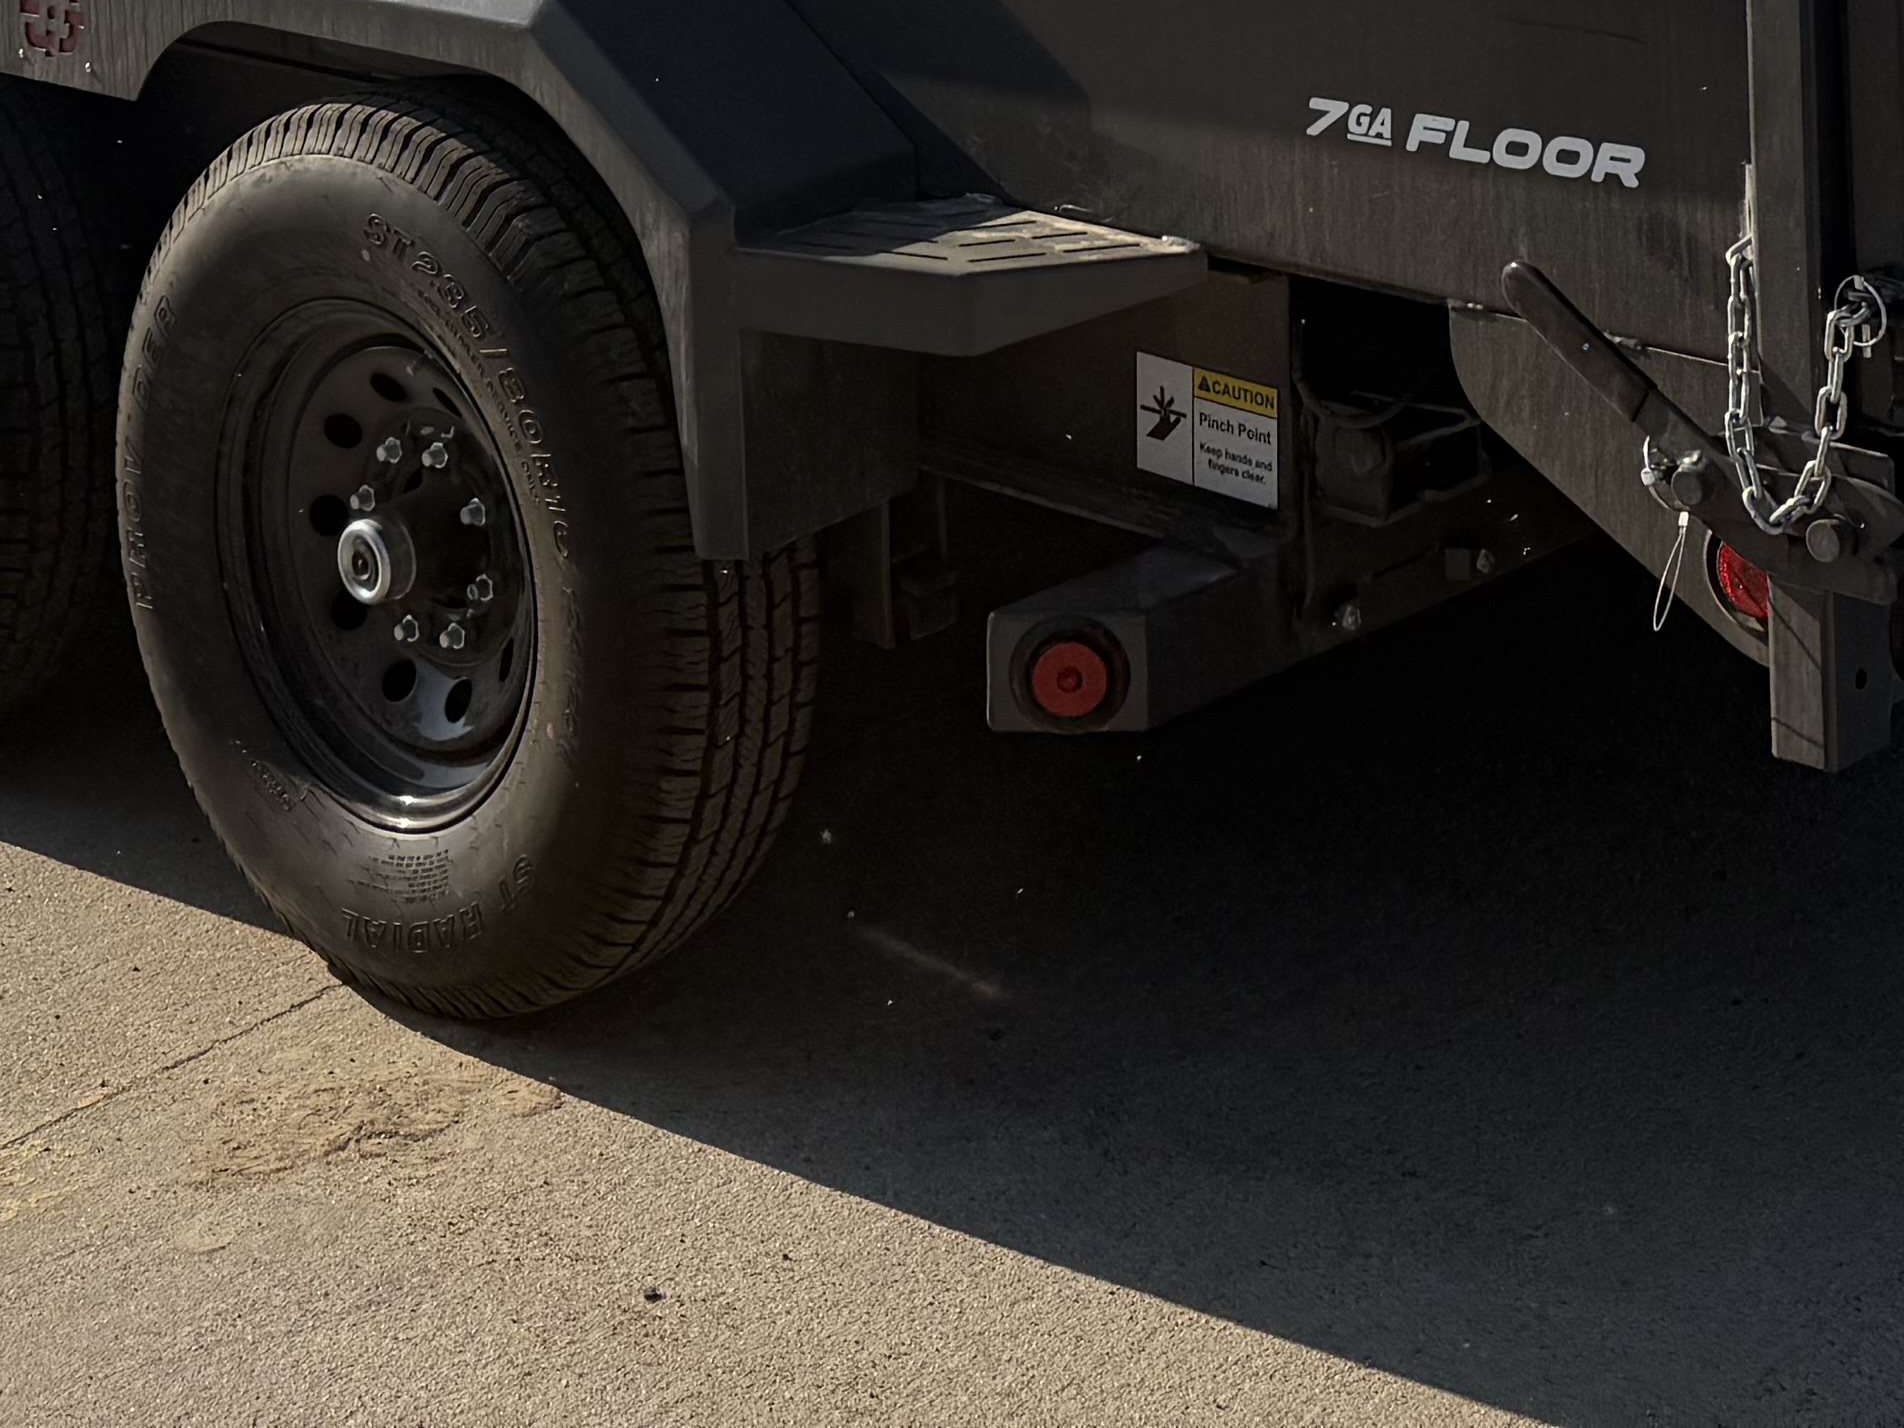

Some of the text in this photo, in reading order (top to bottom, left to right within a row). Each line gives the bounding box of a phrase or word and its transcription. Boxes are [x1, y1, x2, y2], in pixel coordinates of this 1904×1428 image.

[1406, 113, 1646, 188] FLOOR
[1212, 380, 1275, 410] CAUTION
[1199, 412, 1272, 445] Pinch Point
[1199, 442, 1273, 472] Keep hands and
[1208, 458, 1267, 485] fingers clear.
[341, 900, 484, 954] RADIAL
